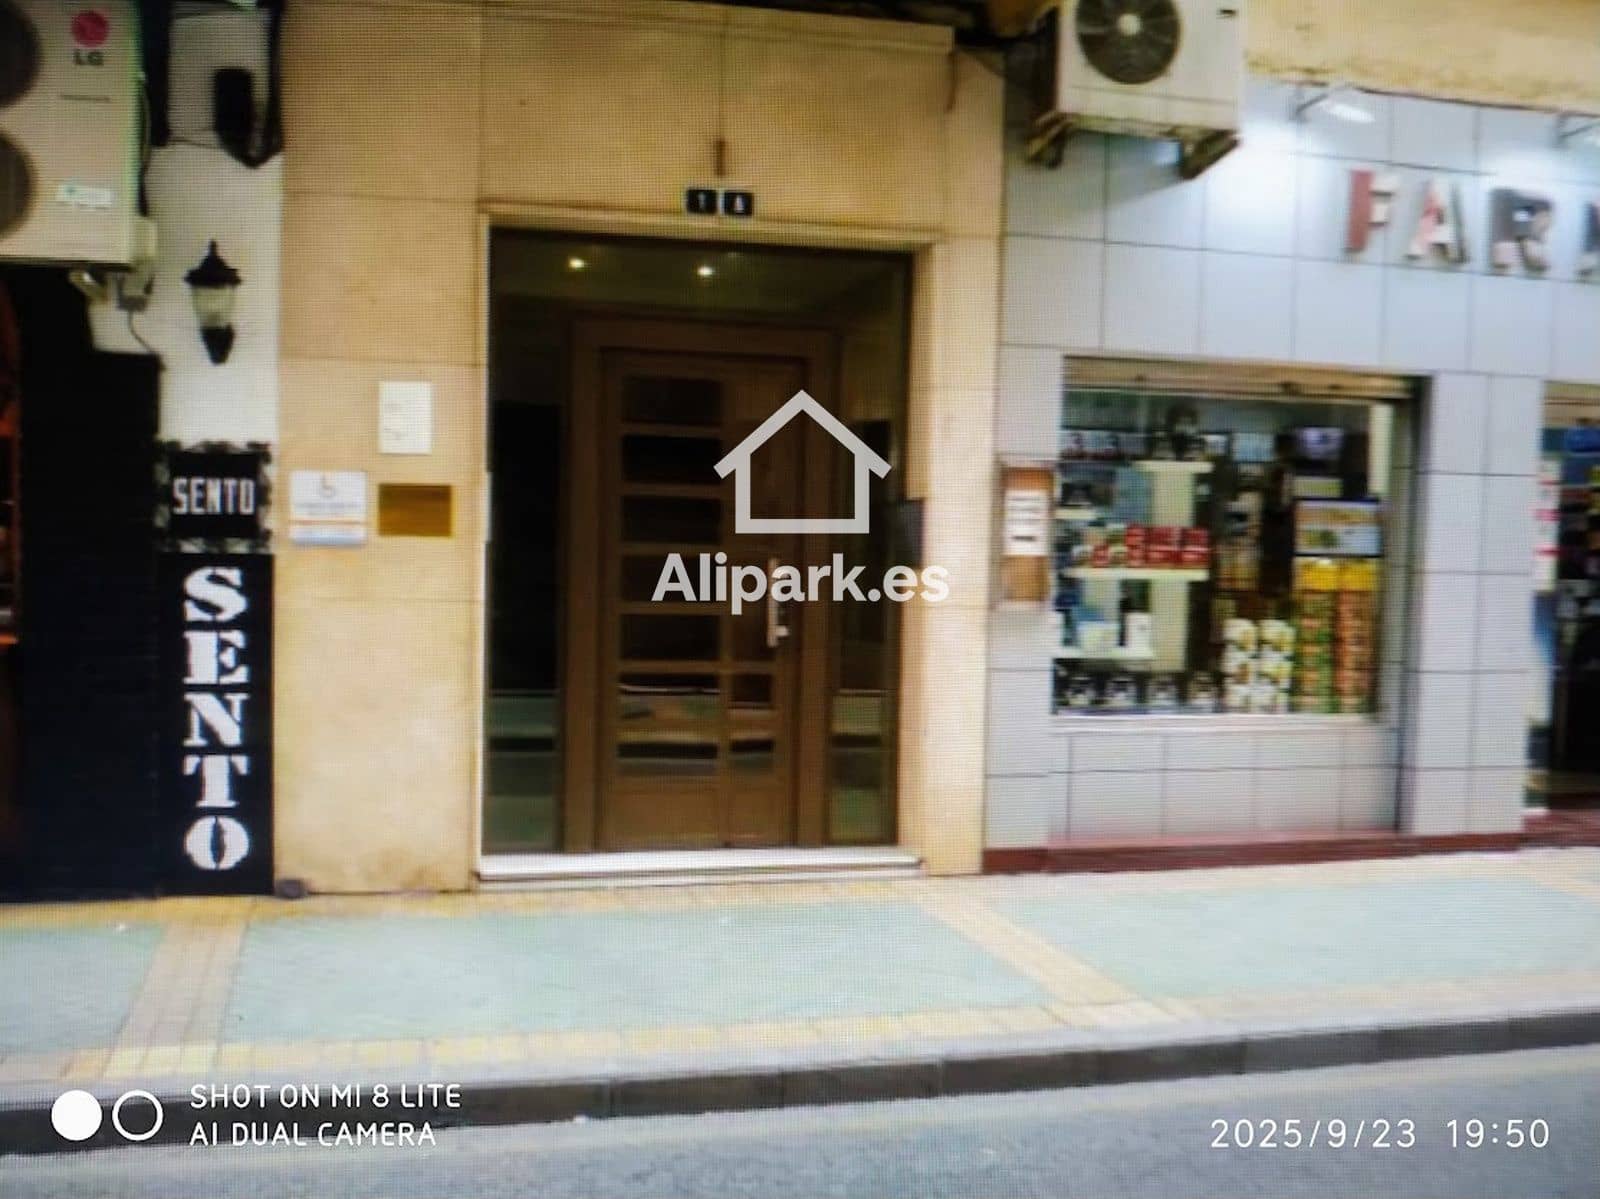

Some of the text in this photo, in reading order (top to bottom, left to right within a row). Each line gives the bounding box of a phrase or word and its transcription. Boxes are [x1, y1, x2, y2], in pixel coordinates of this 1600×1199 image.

[74, 50, 104, 66] LG
[172, 477, 256, 515] SENTO
[183, 566, 250, 870] SENTO
